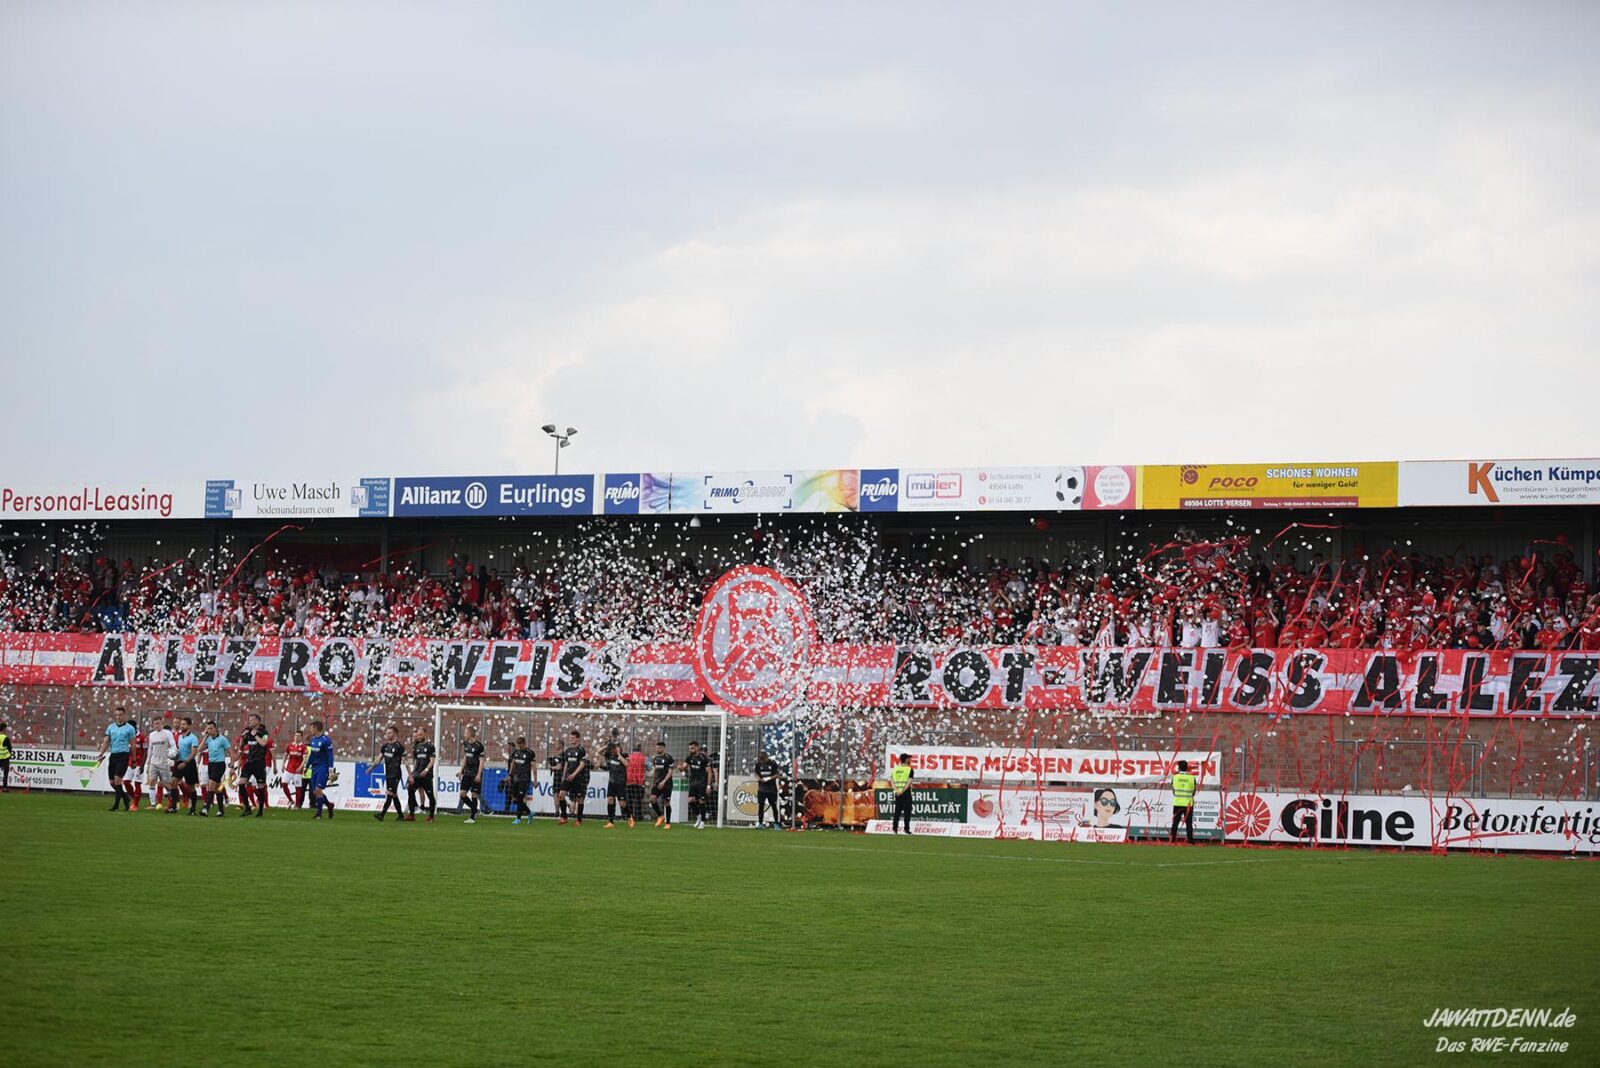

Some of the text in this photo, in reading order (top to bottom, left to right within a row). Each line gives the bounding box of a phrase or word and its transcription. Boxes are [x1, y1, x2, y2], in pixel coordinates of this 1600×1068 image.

[1266, 467, 1358, 478] SCHÖNES WOHNEN
[861, 481, 897, 497] FRIMO
[911, 478, 957, 491] müller
[1208, 477, 1258, 489] POCO
[1293, 481, 1358, 490] für weniger Geld!
[253, 482, 341, 501] Uwe Masch
[400, 486, 461, 505] Allianz
[499, 483, 586, 508] Eurlings
[604, 484, 640, 501] FRIMO
[1, 487, 173, 517] Personal-Leasing
[1204, 499, 1252, 507] LOTTE-WERSEN
[256, 504, 335, 516] bodenundraum.com
[94, 634, 257, 686] ALLEZ
[892, 650, 1600, 713] ROT-WEISS ALLEZ
[17, 766, 57, 775] Marken
[984, 754, 1073, 774] MÜSSEN
[911, 802, 961, 815] QUALITÄT
[1281, 798, 1414, 842] Gilne
[914, 826, 946, 834] BECKHOFF
[959, 829, 992, 837] BECKHOFF
